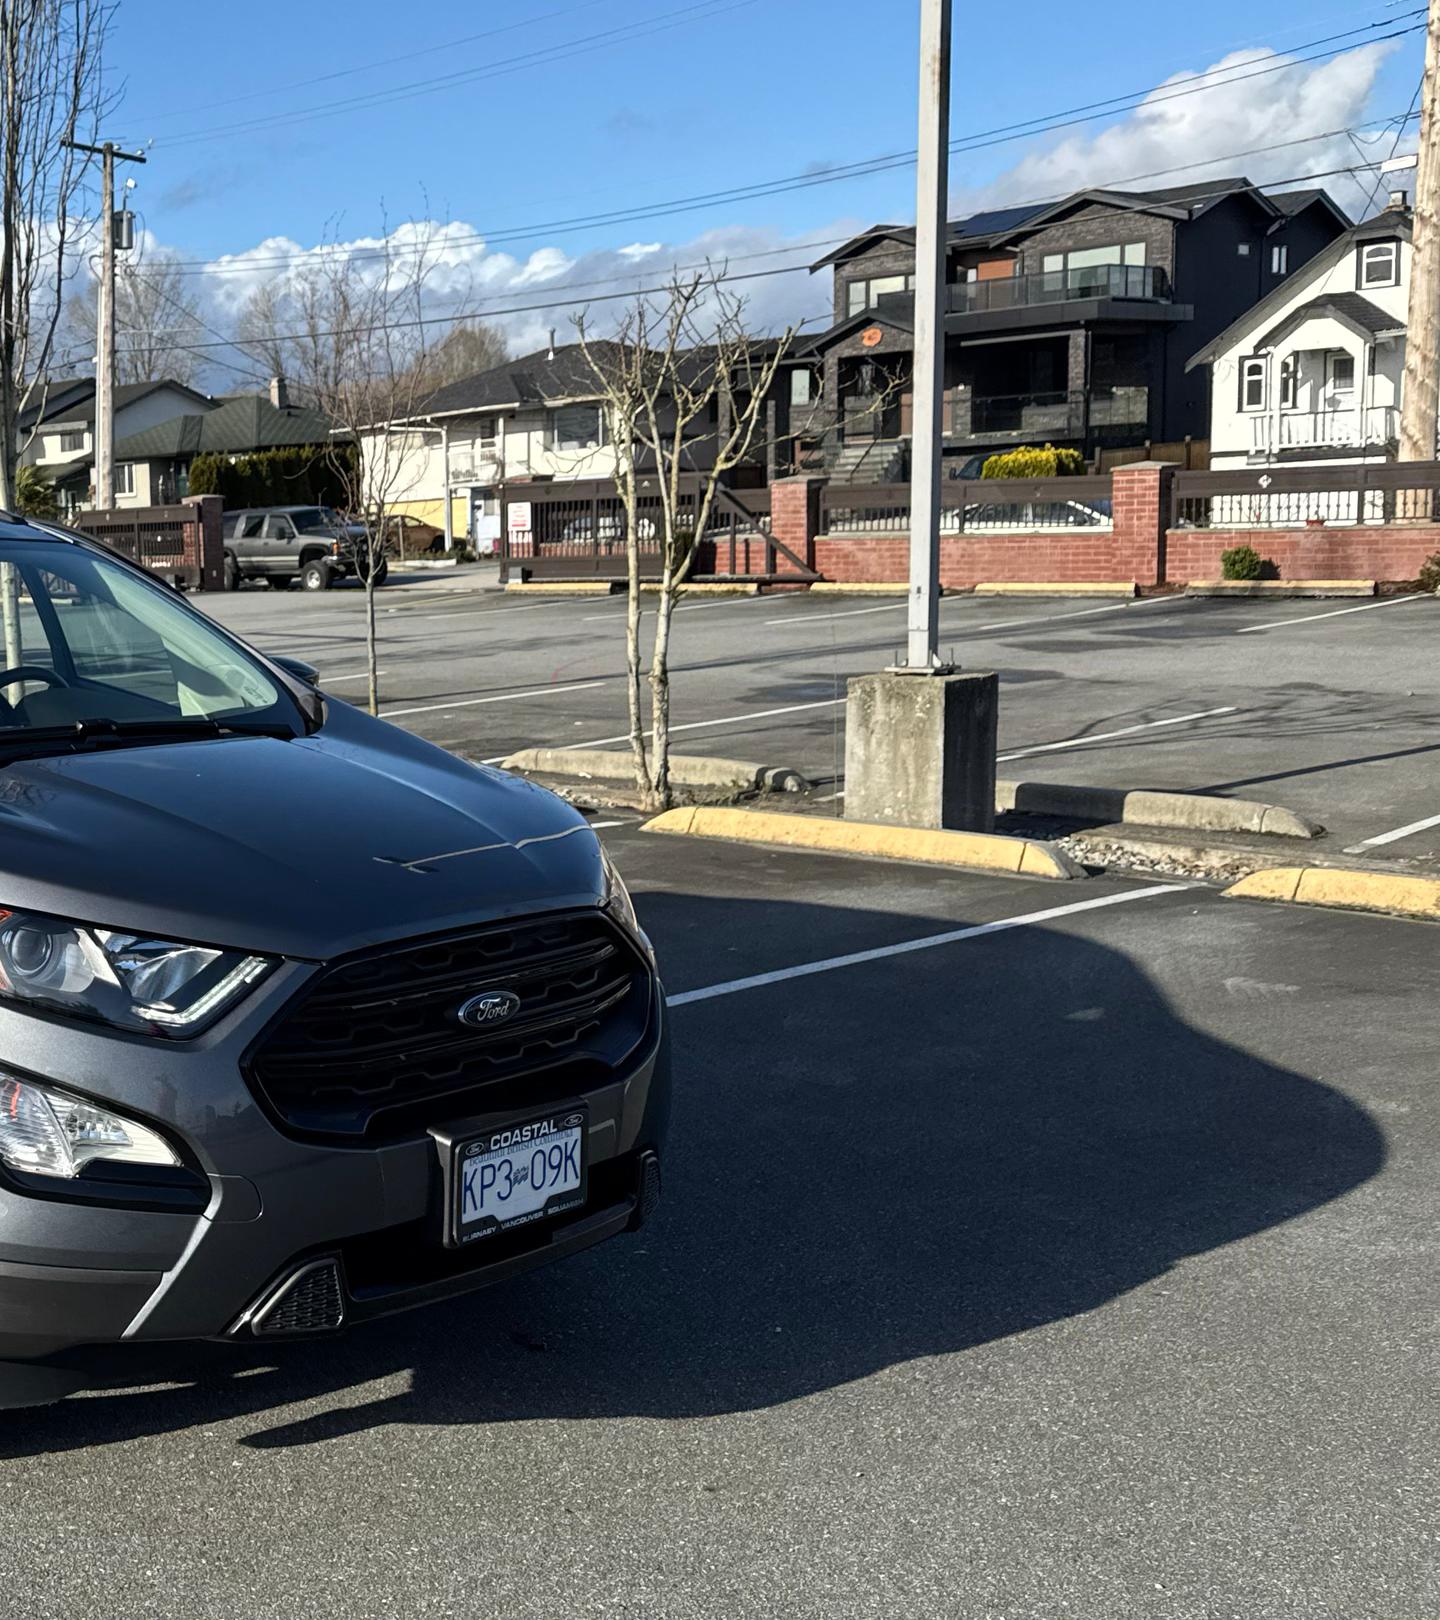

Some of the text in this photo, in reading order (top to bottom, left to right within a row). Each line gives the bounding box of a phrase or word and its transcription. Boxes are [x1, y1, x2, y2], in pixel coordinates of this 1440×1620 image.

[477, 997, 510, 1021] Ford
[490, 1119, 558, 1150] COASTAL
[463, 1138, 580, 1214] KP3 09K
[501, 1211, 544, 1230] VANCOUVER
